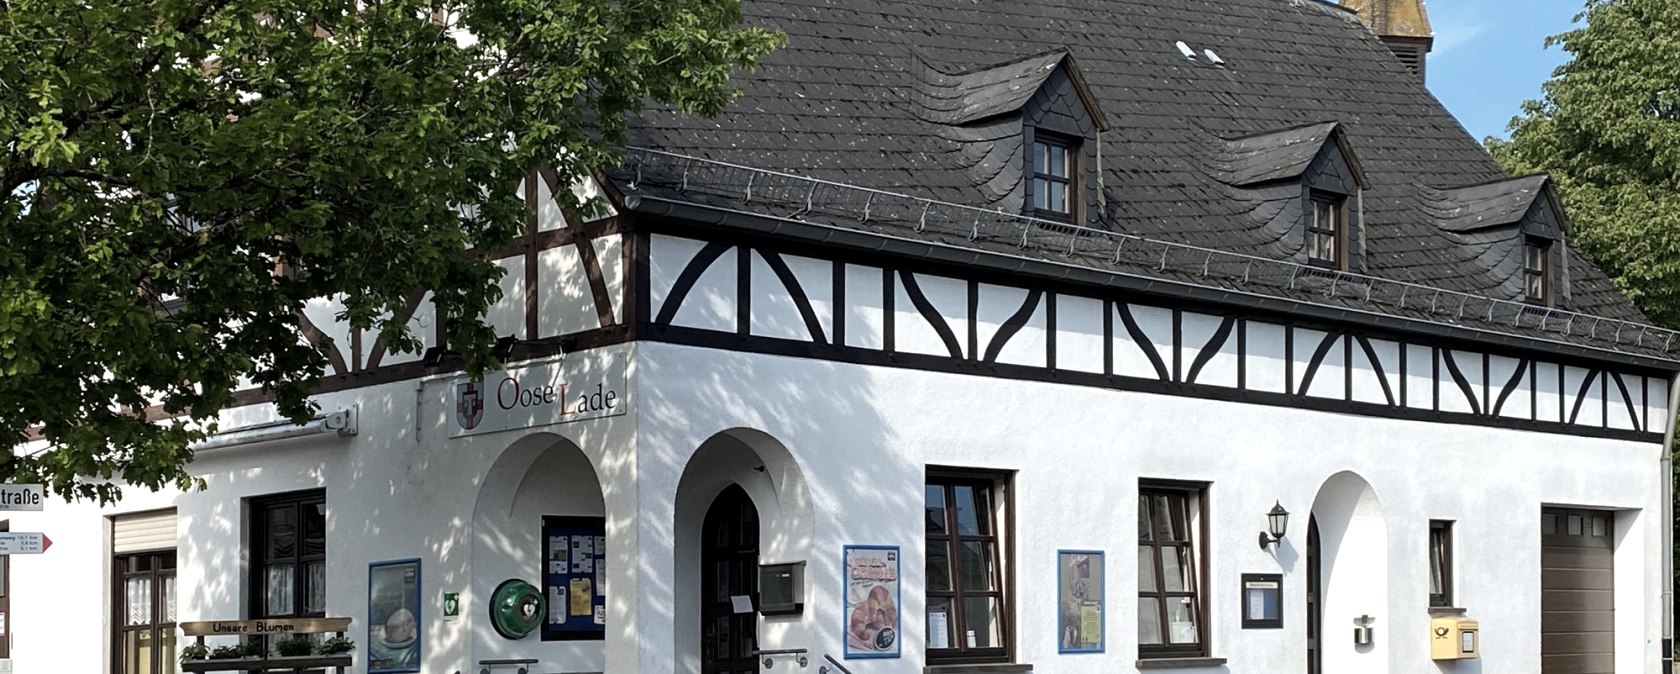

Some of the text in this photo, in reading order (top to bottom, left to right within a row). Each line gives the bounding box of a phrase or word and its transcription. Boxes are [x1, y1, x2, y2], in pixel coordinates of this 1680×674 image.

[497, 376, 616, 416] Oose Lade
[1, 488, 40, 505] traße
[212, 621, 295, 633] Unsere Blumen
